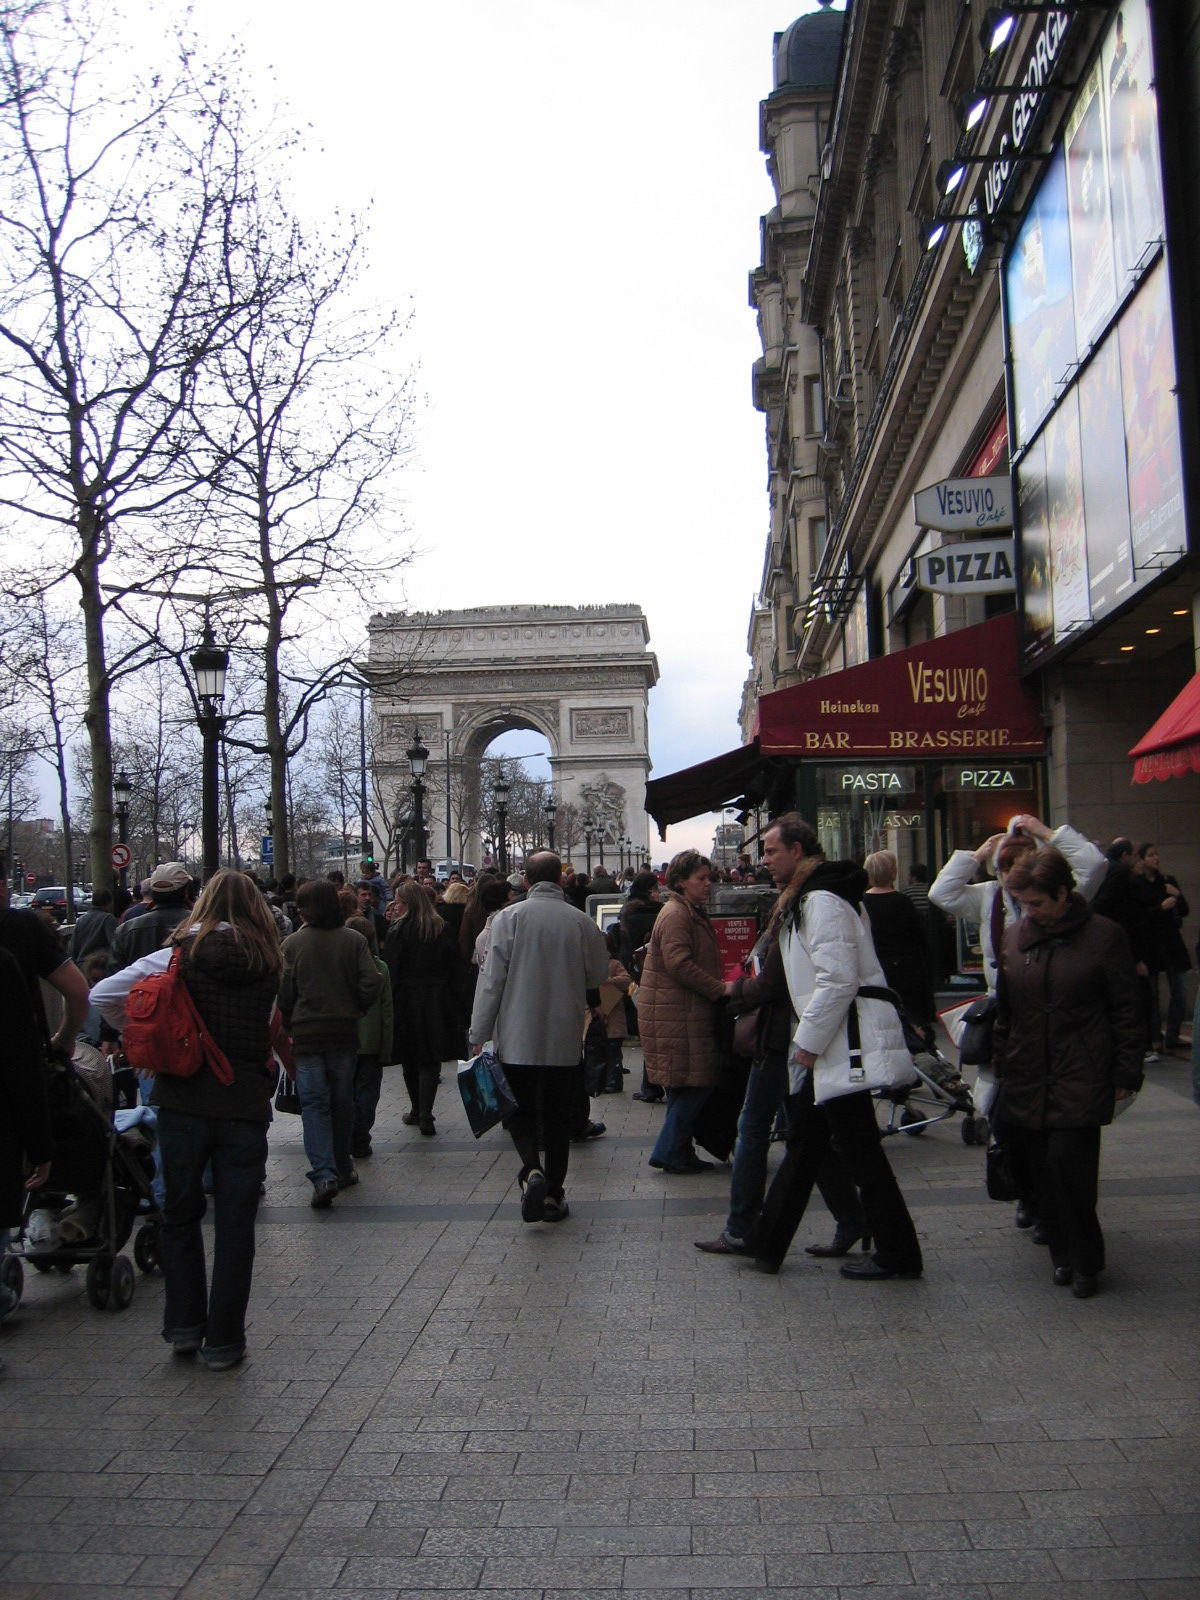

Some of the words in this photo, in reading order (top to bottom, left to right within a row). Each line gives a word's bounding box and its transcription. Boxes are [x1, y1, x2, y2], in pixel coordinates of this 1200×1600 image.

[984, 134, 1009, 214] UGC
[936, 485, 994, 515] VESUVIO
[976, 506, 1006, 527] Café
[928, 551, 1012, 585] PIZZA
[908, 662, 988, 703] VESUVIO
[820, 700, 879, 714] Heineken
[957, 702, 987, 719] Café
[804, 732, 851, 749] BAR
[889, 729, 1011, 749] BRASSERIE
[842, 773, 901, 790] PASTA
[960, 770, 1015, 787] PIZZA
